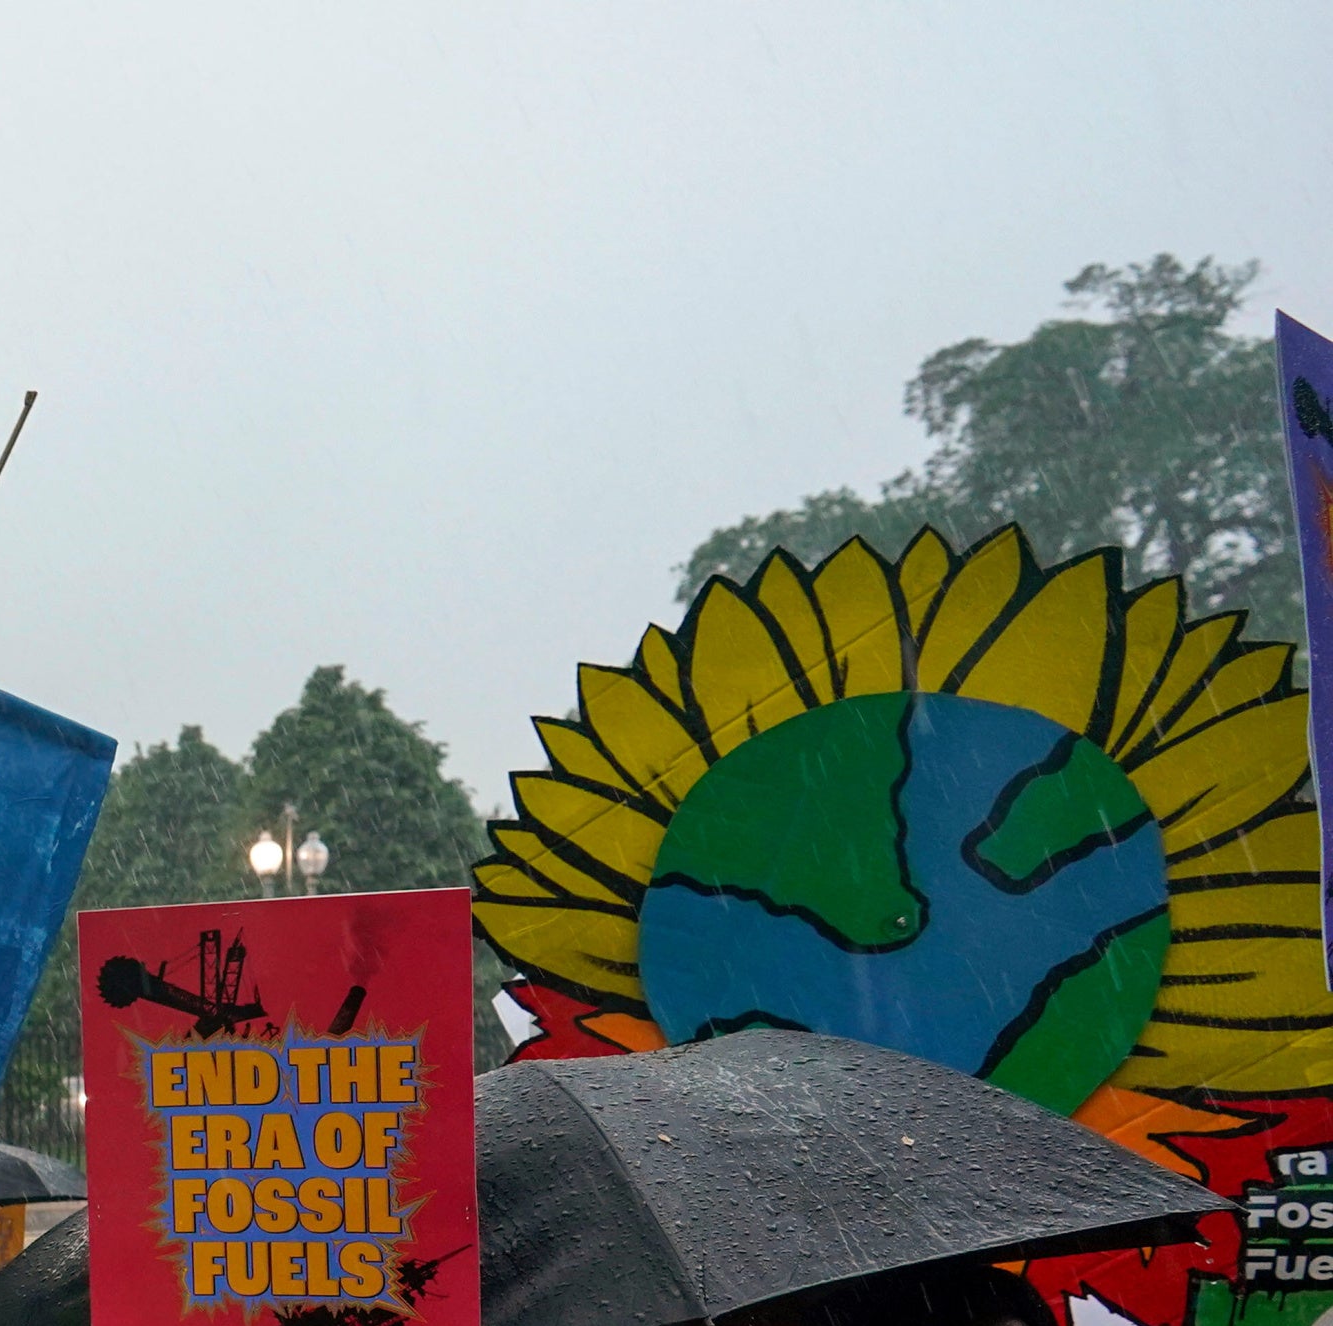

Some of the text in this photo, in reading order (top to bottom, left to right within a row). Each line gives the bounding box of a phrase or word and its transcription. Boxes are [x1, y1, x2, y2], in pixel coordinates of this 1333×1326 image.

[151, 1045, 417, 1108] END THE
[171, 1111, 400, 1170] ERA OF
[172, 1177, 402, 1235] FOSSIL
[192, 1240, 385, 1298] FUELS
